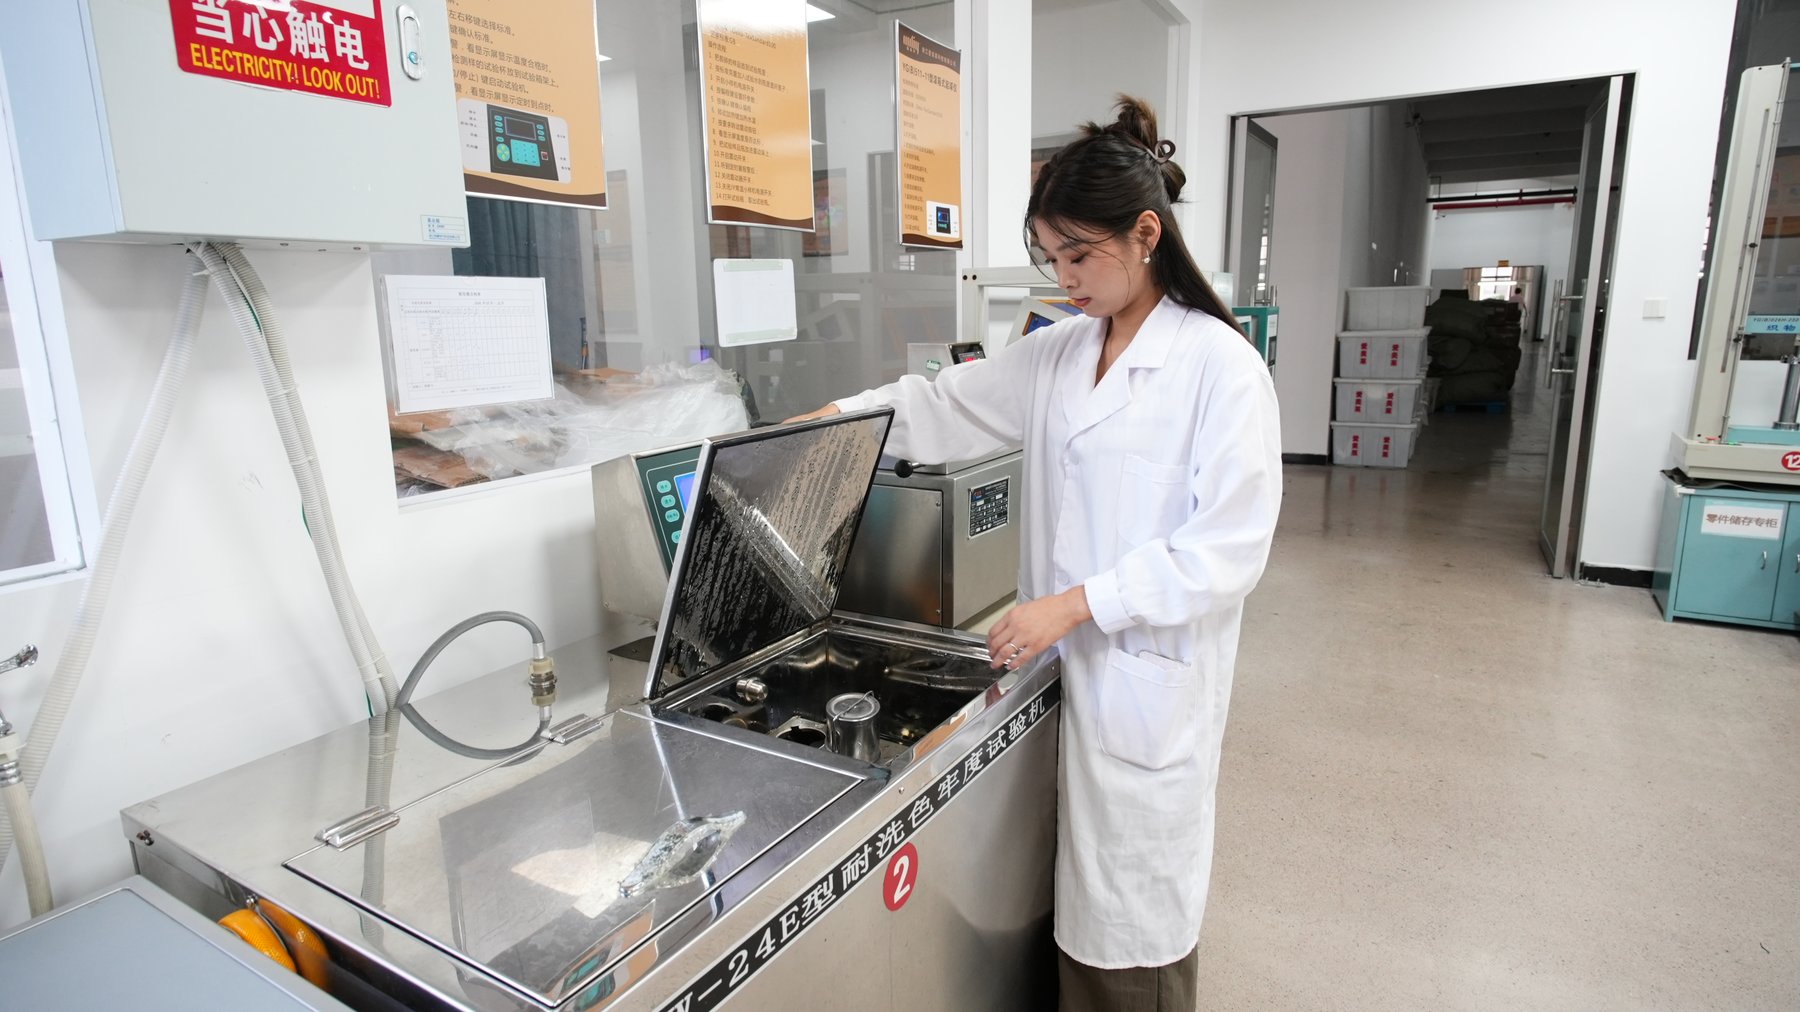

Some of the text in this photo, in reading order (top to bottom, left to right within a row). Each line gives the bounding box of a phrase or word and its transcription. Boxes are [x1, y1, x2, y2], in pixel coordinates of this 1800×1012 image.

[193, 0, 370, 70] 当心触电
[190, 43, 381, 99] ELECTRICITY! LOOK OUT!
[1785, 453, 1800, 469] 12
[1706, 513, 1779, 529] 零件储存专柜
[892, 855, 911, 905] 2
